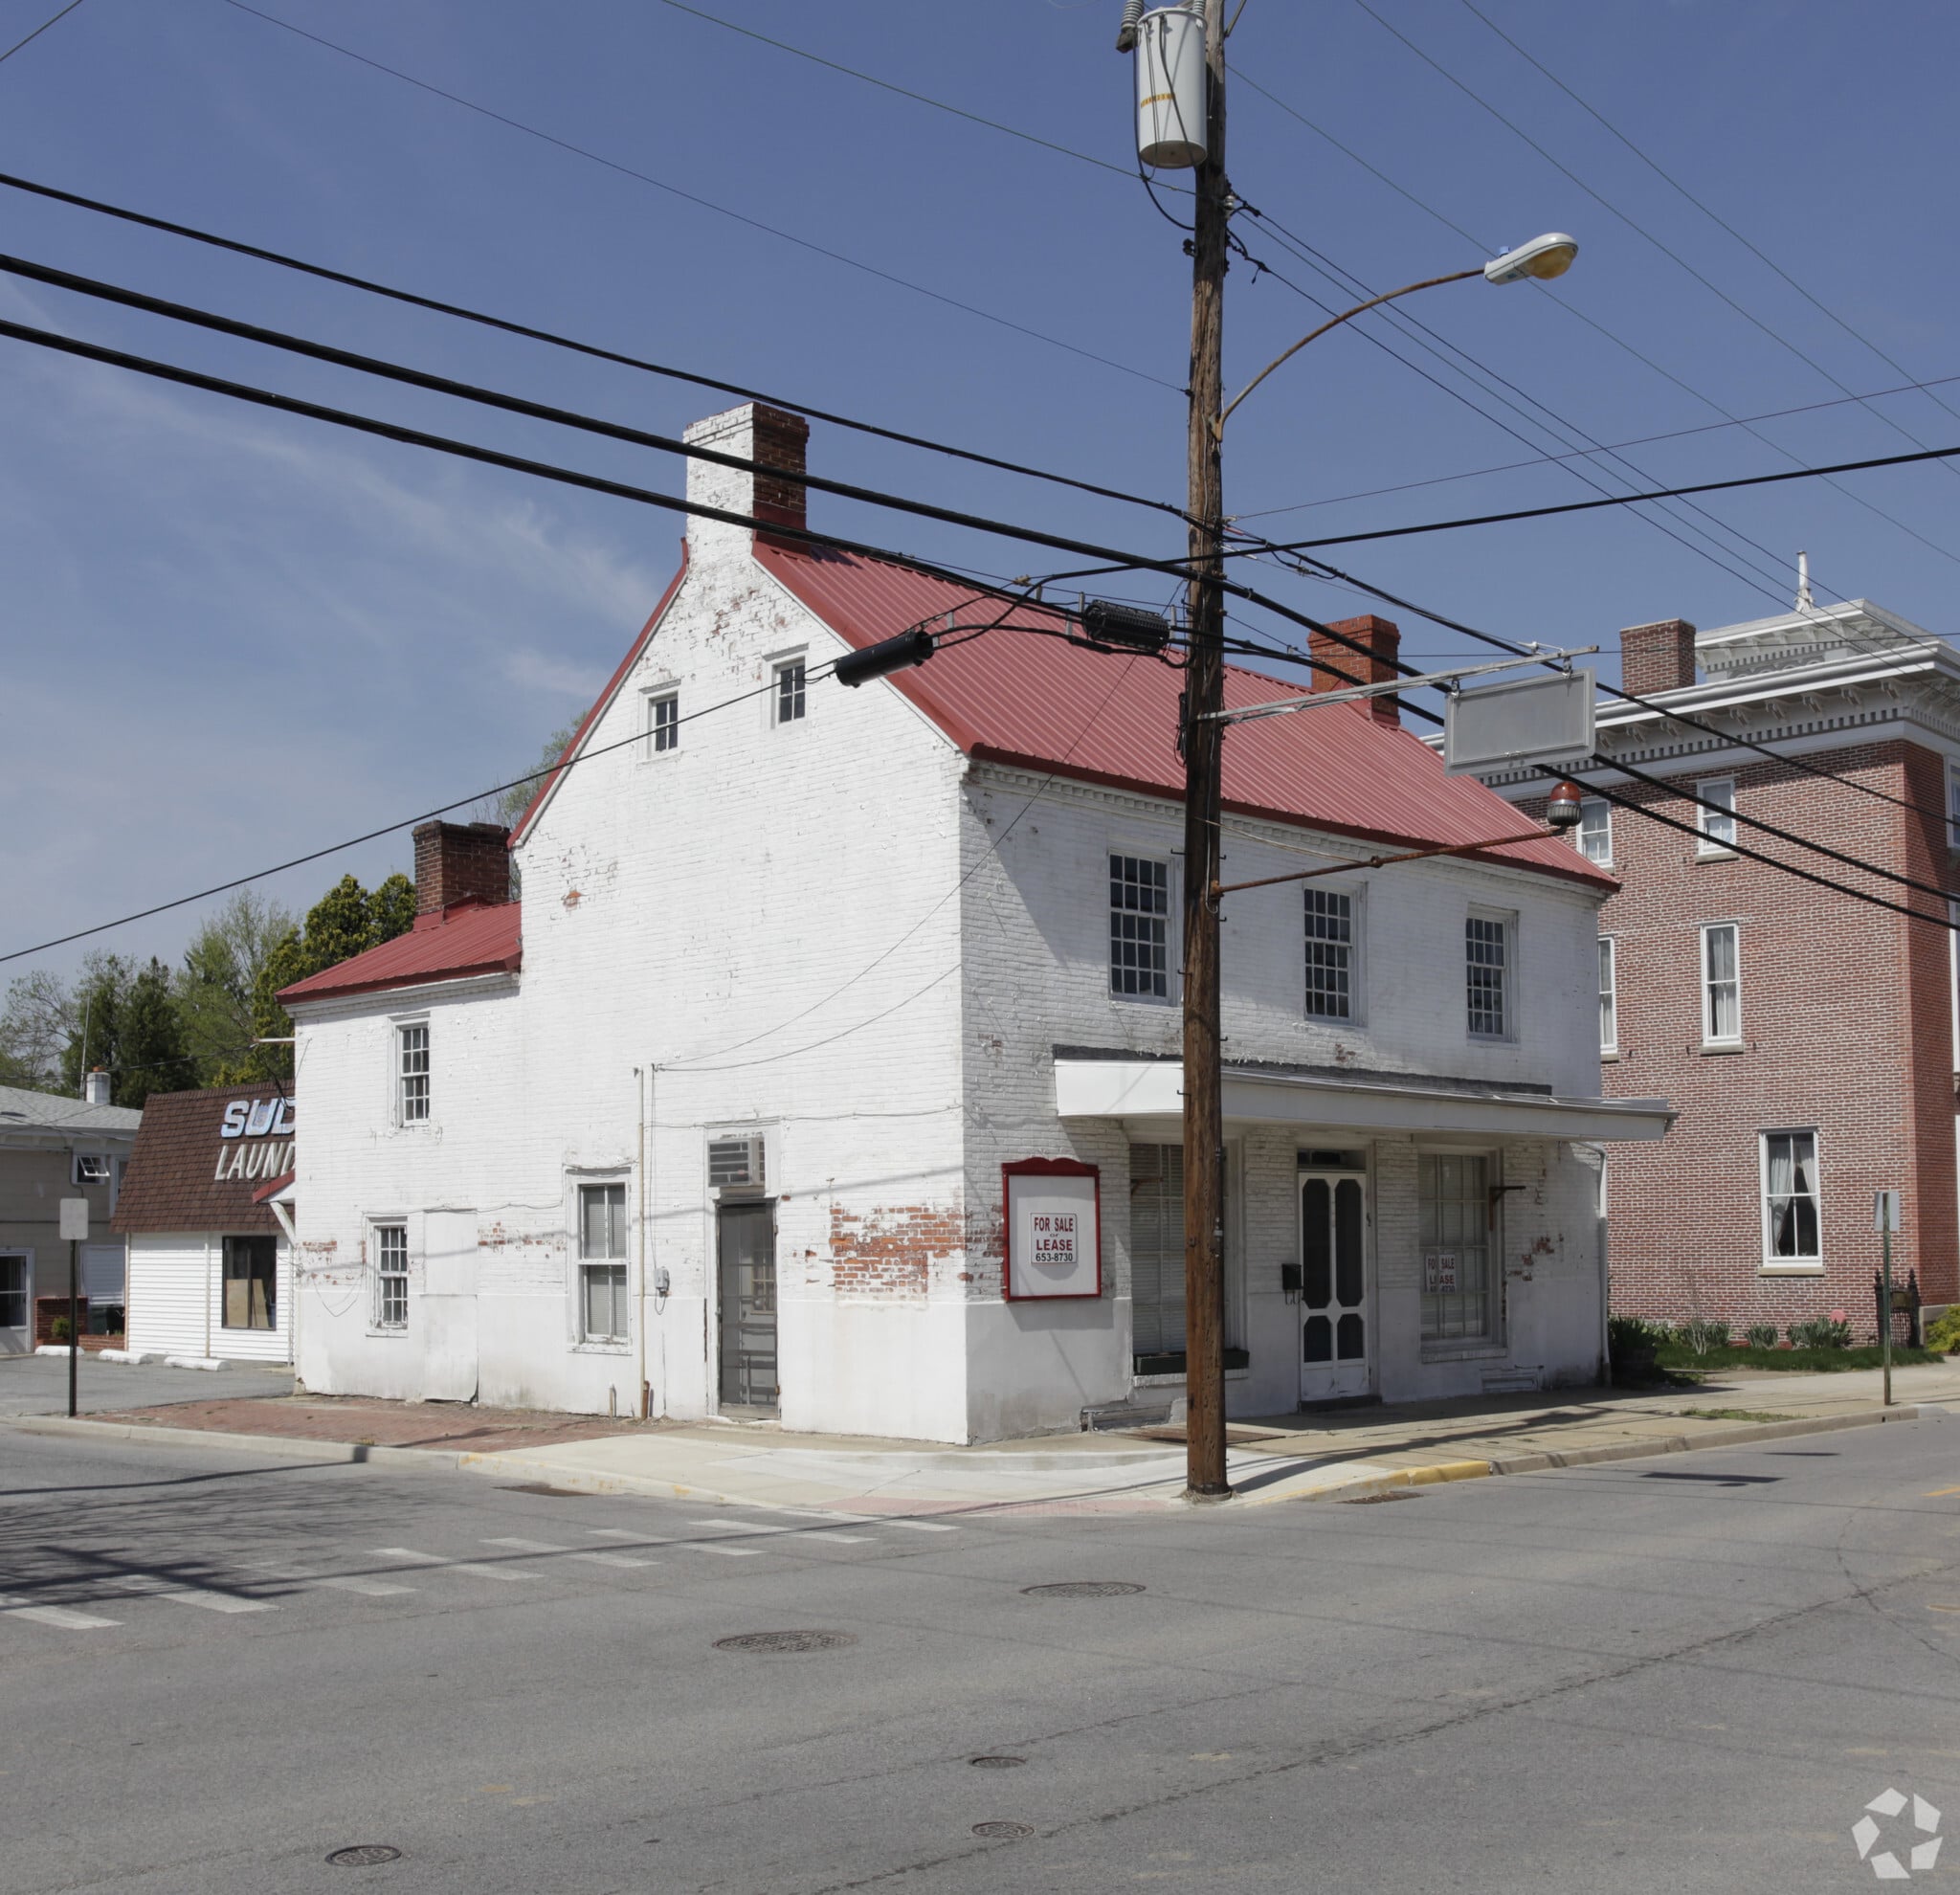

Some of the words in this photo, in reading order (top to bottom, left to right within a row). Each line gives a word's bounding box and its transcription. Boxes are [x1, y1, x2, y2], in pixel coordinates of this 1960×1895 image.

[1034, 1216, 1050, 1232] FOR
[1055, 1217, 1074, 1232] SALE
[1036, 1239, 1073, 1251] LEASE
[1036, 1253, 1073, 1261] 653-8730
